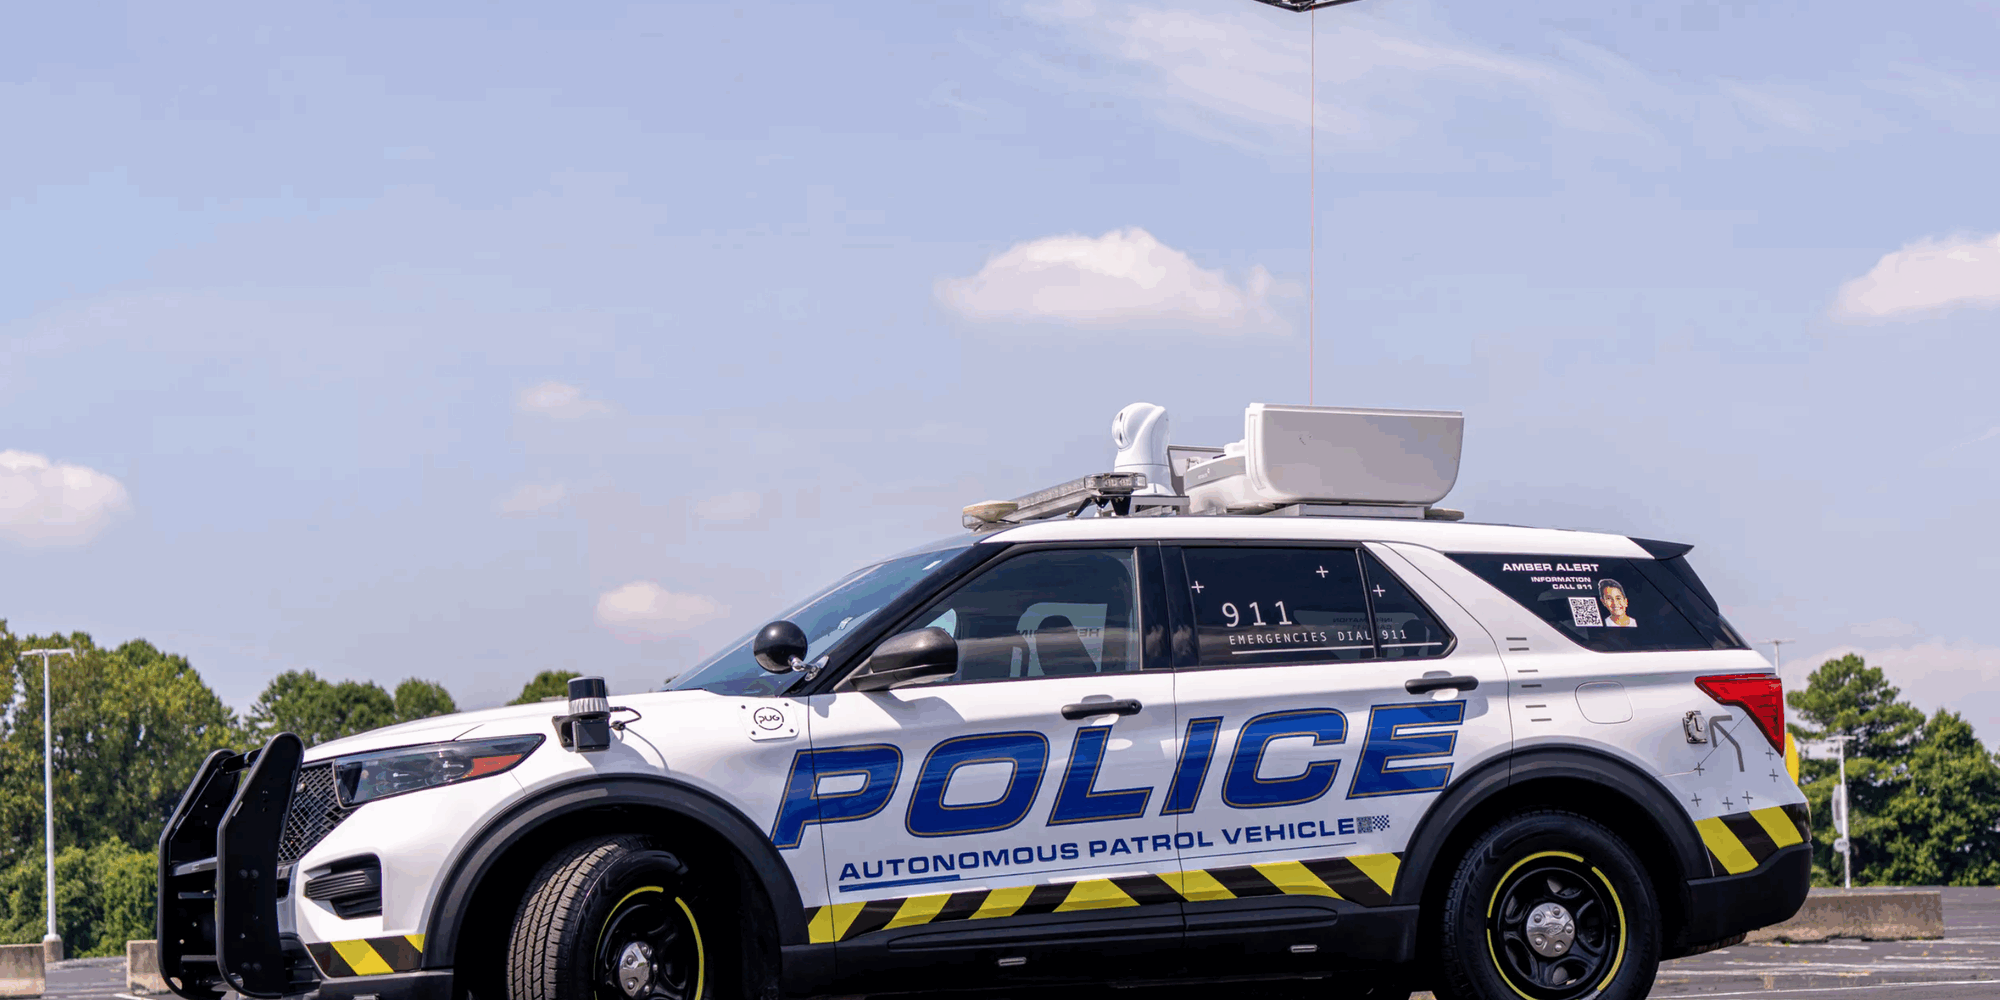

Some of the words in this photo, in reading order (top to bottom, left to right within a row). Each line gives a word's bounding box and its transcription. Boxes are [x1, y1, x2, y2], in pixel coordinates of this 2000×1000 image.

[1502, 563, 1552, 572] AMBER
[1556, 563, 1600, 572] ALERT
[1221, 601, 1293, 627] 911
[1229, 631, 1327, 646] EMERGENCIES
[1338, 631, 1372, 642] DIAL
[1382, 629, 1407, 640] 911
[770, 700, 1466, 849] POLICE
[839, 842, 1078, 881] AUTONOMOUS
[1089, 830, 1213, 857] PATROL
[1221, 817, 1355, 845] VEHICLE
